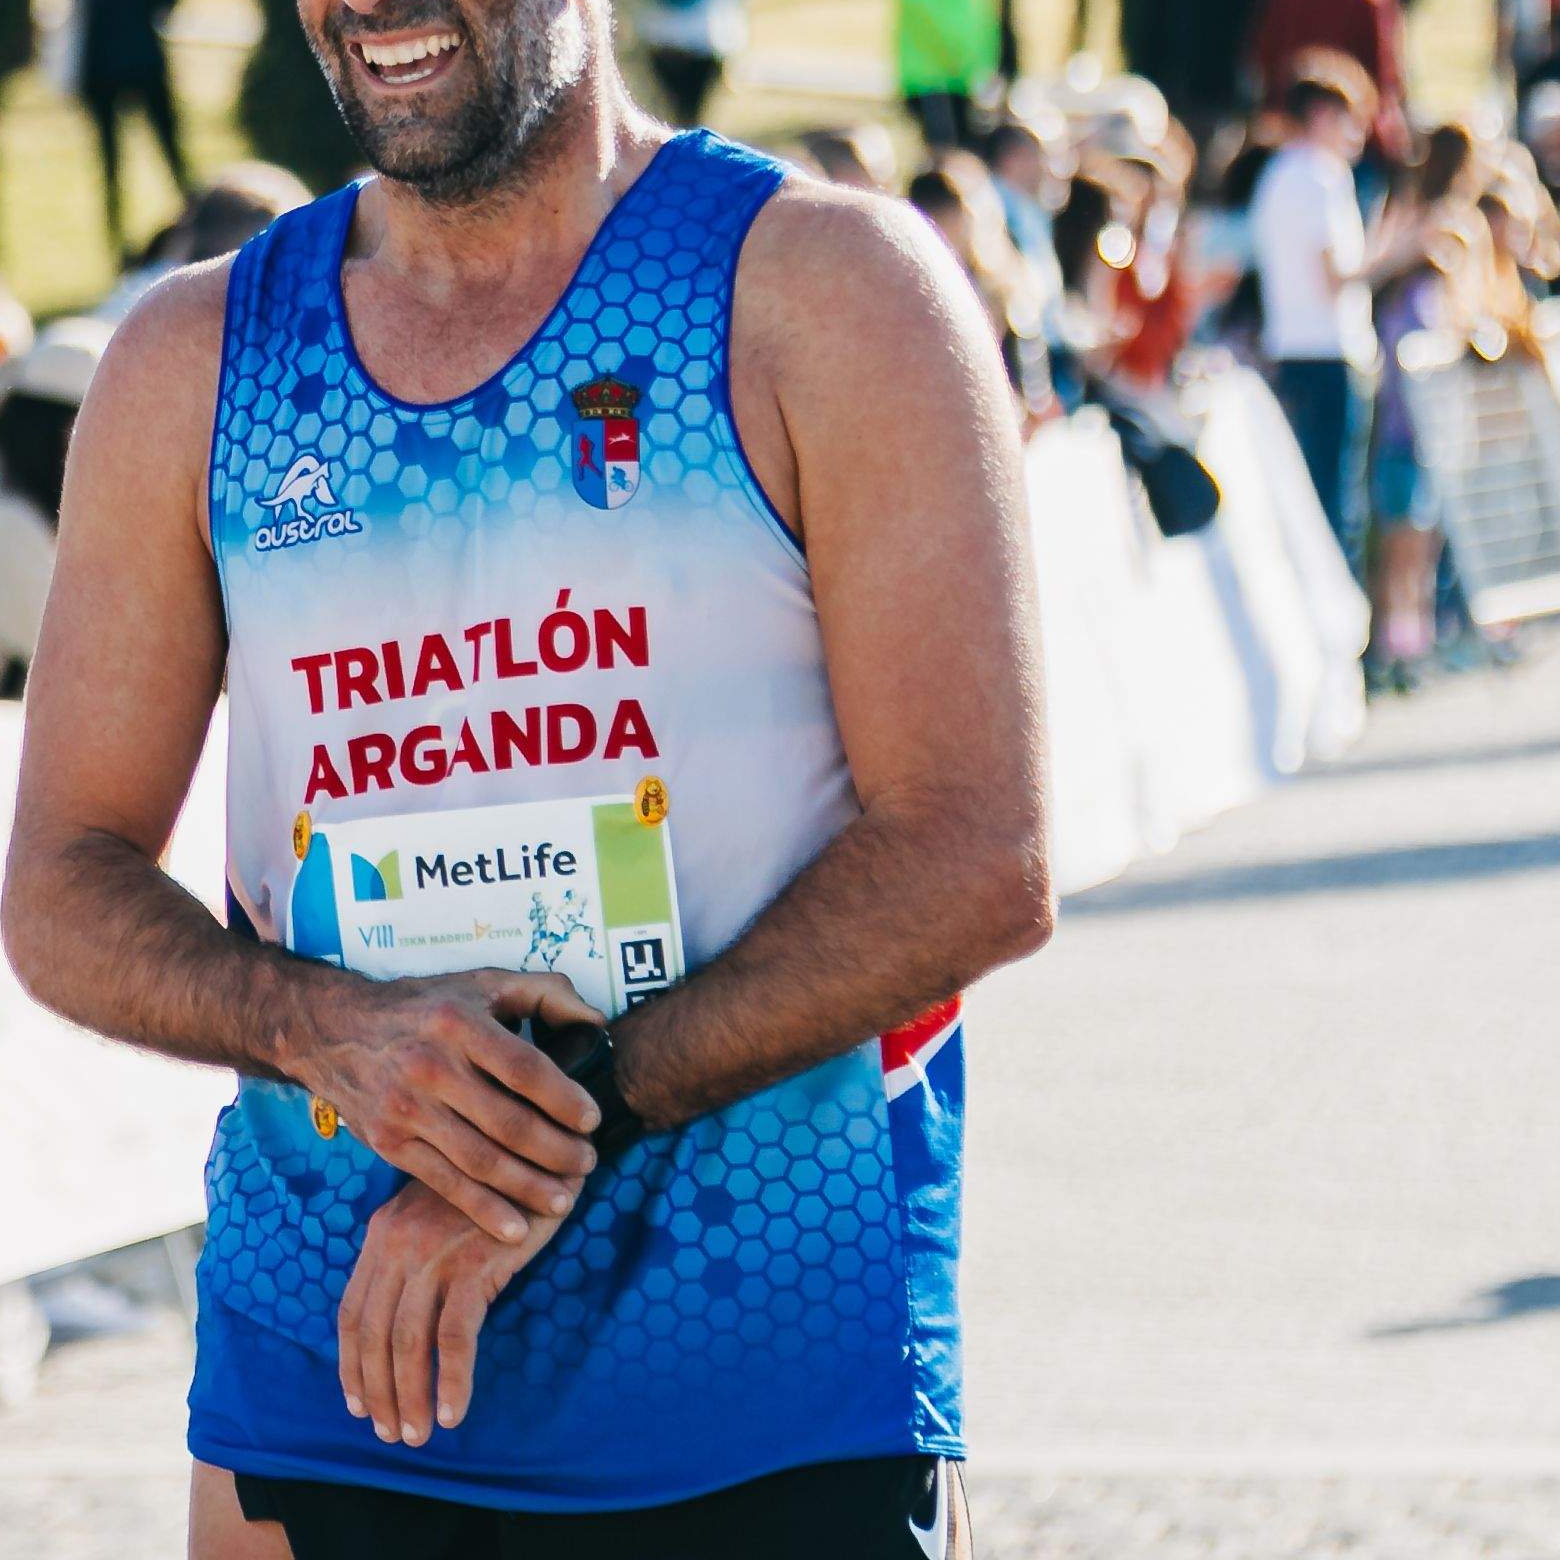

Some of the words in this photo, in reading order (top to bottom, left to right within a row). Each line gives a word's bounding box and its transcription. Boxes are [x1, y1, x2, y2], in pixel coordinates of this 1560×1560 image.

[255, 510, 361, 550] austral
[291, 588, 650, 715] TRIATLÓN
[303, 699, 660, 804] ARGANDA
[414, 842, 577, 889] MetLife
[358, 924, 394, 949] VIII
[429, 931, 474, 945] MADRID
